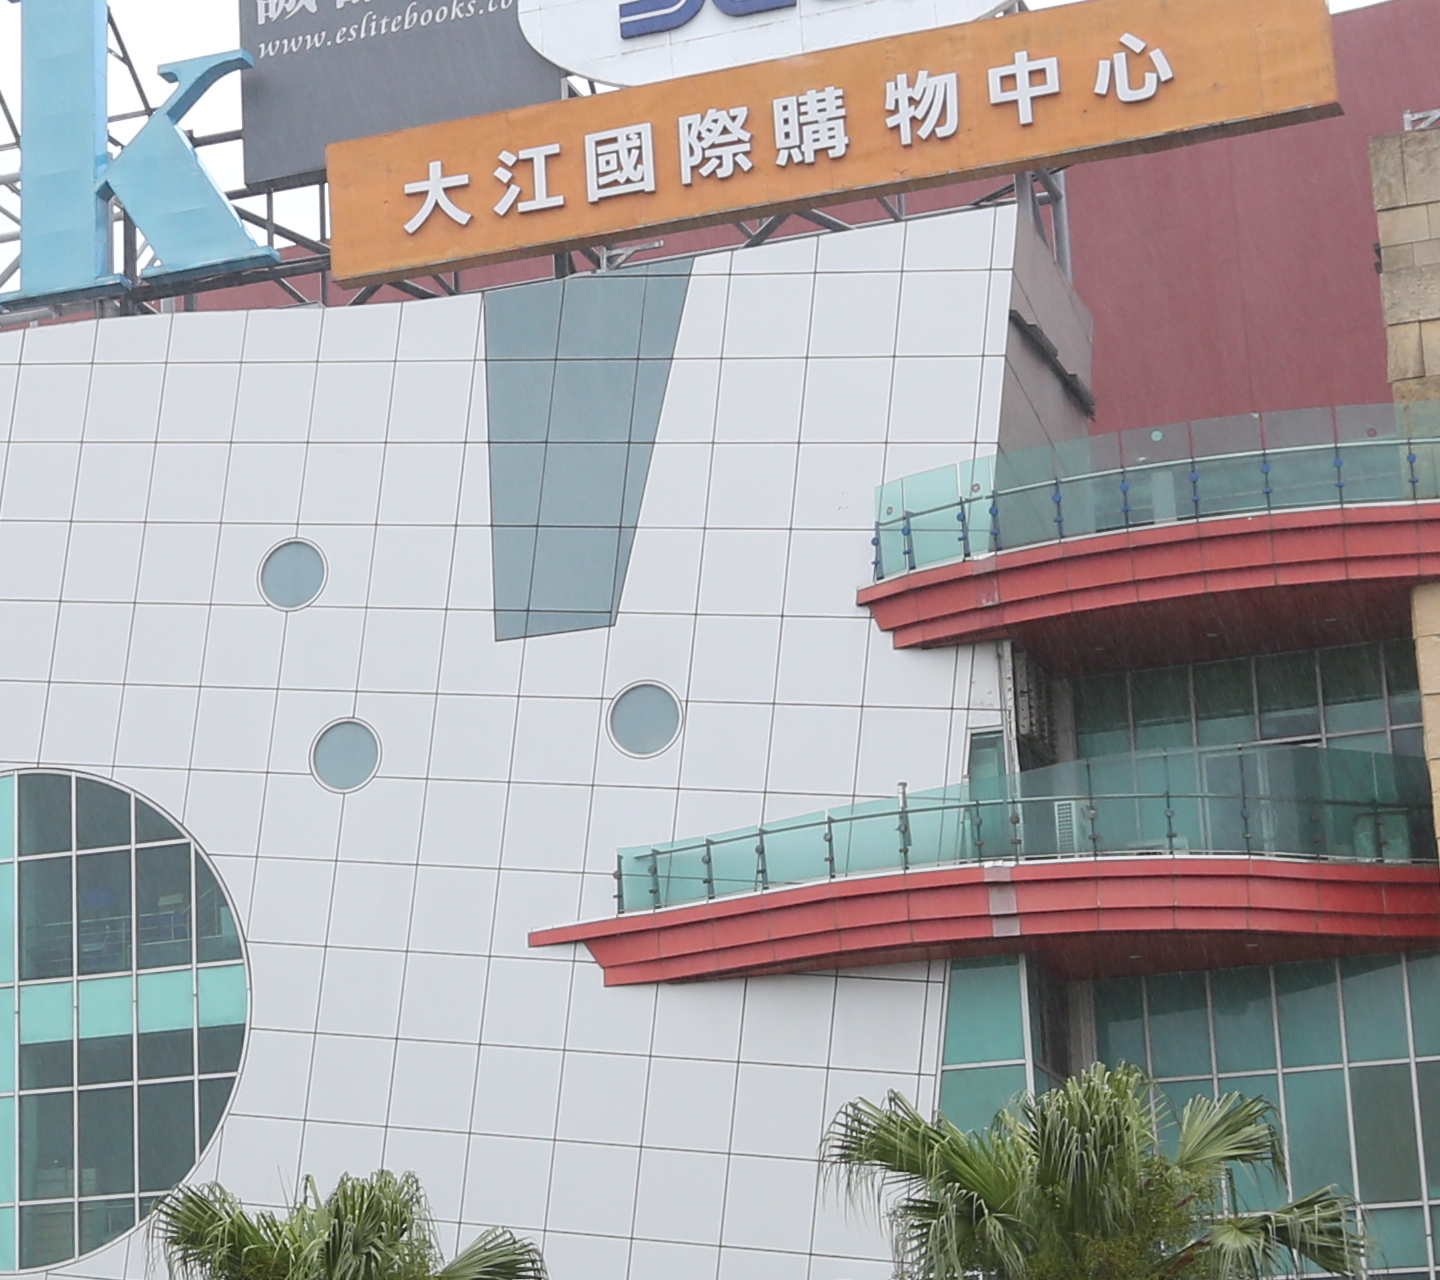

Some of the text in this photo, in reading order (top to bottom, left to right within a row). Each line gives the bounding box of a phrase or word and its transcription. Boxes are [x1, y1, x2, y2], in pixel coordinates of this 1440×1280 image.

[403, 32, 1175, 236] 大江國際購物中心
